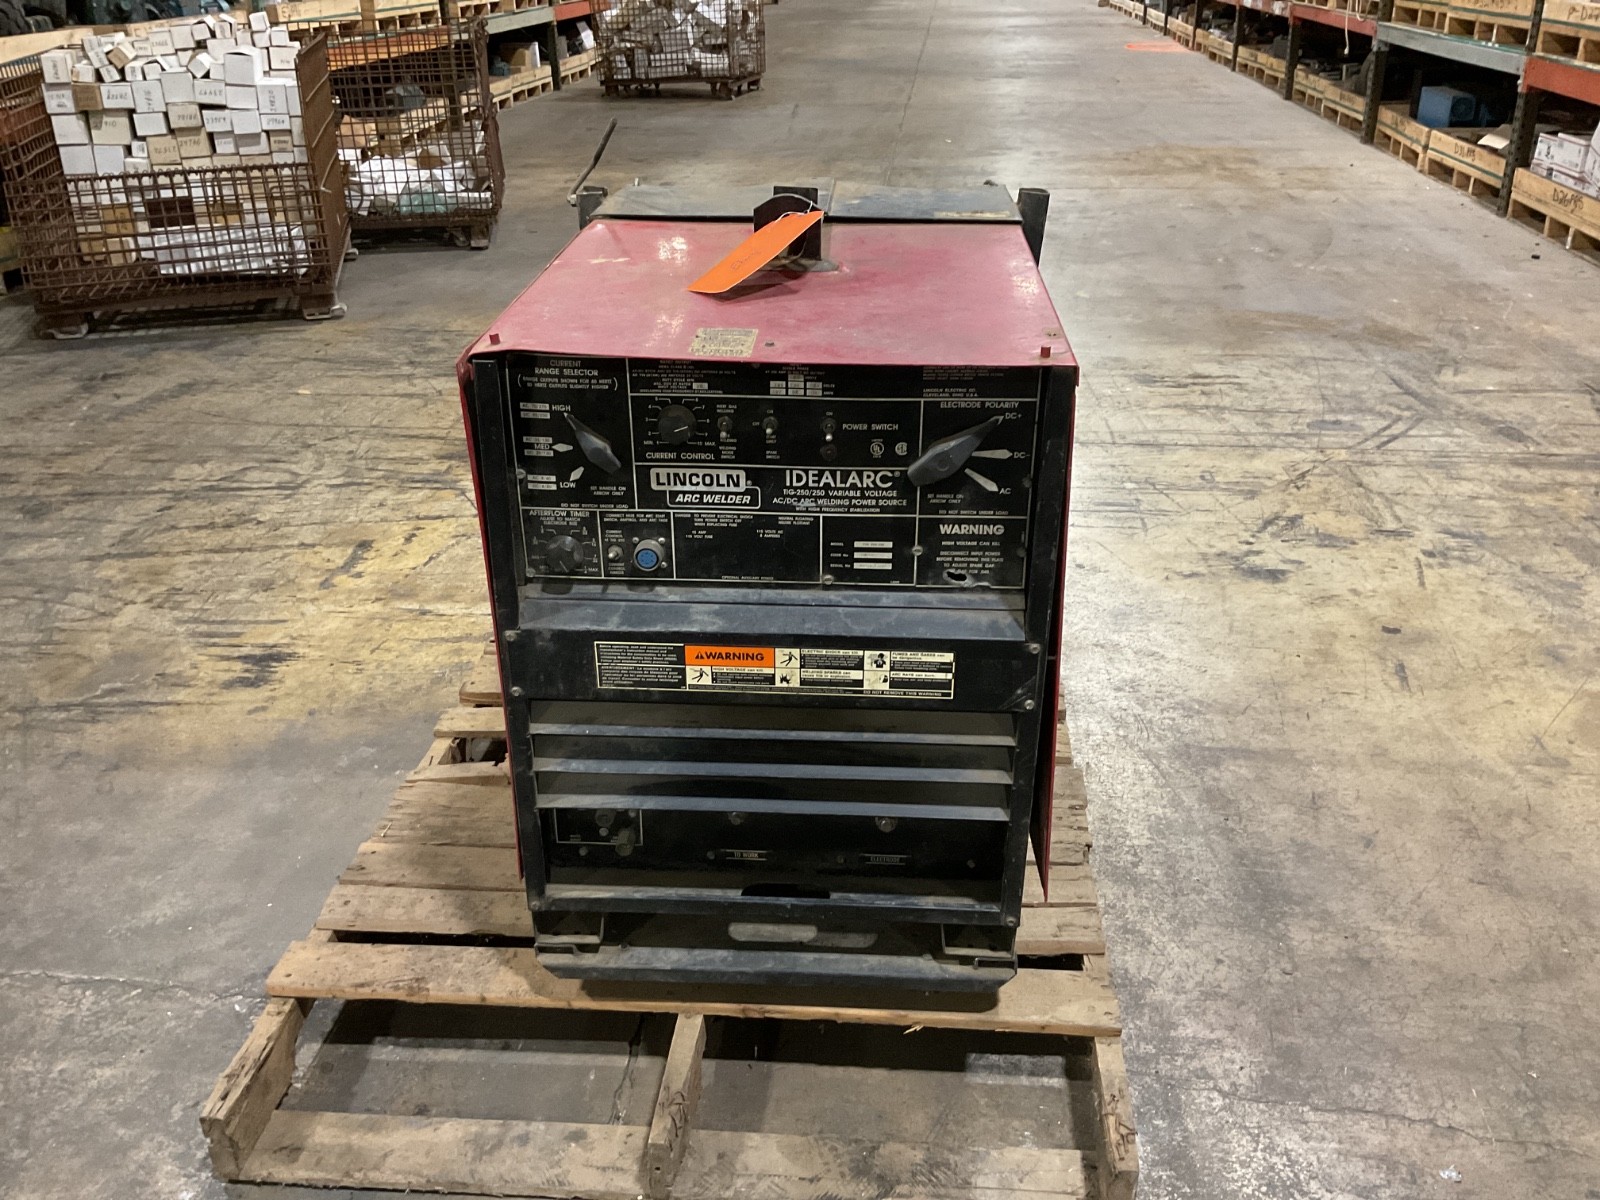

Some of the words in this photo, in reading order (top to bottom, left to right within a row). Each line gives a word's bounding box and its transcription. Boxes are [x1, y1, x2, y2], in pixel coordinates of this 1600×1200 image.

[549, 360, 582, 368] CURRENT
[534, 367, 560, 376] RANGE
[562, 369, 599, 377] SELECTOR
[551, 404, 571, 412] HIGH
[940, 401, 981, 409] ELECTRODE
[984, 402, 1020, 410] POLARITY
[842, 423, 868, 431] POWER
[645, 452, 678, 460] CURRENT
[680, 452, 716, 461] CONTROL
[655, 472, 741, 488] LINCOLN
[559, 481, 576, 489] LOW
[783, 488, 825, 497] TIG-250/250
[828, 489, 861, 497] VARIABLE
[999, 487, 1011, 495] AC
[675, 494, 700, 503] ARC
[702, 494, 752, 504] WELDER
[772, 497, 798, 505] AC/DC
[939, 524, 1005, 536] WARNING
[705, 651, 764, 662] WARNING
